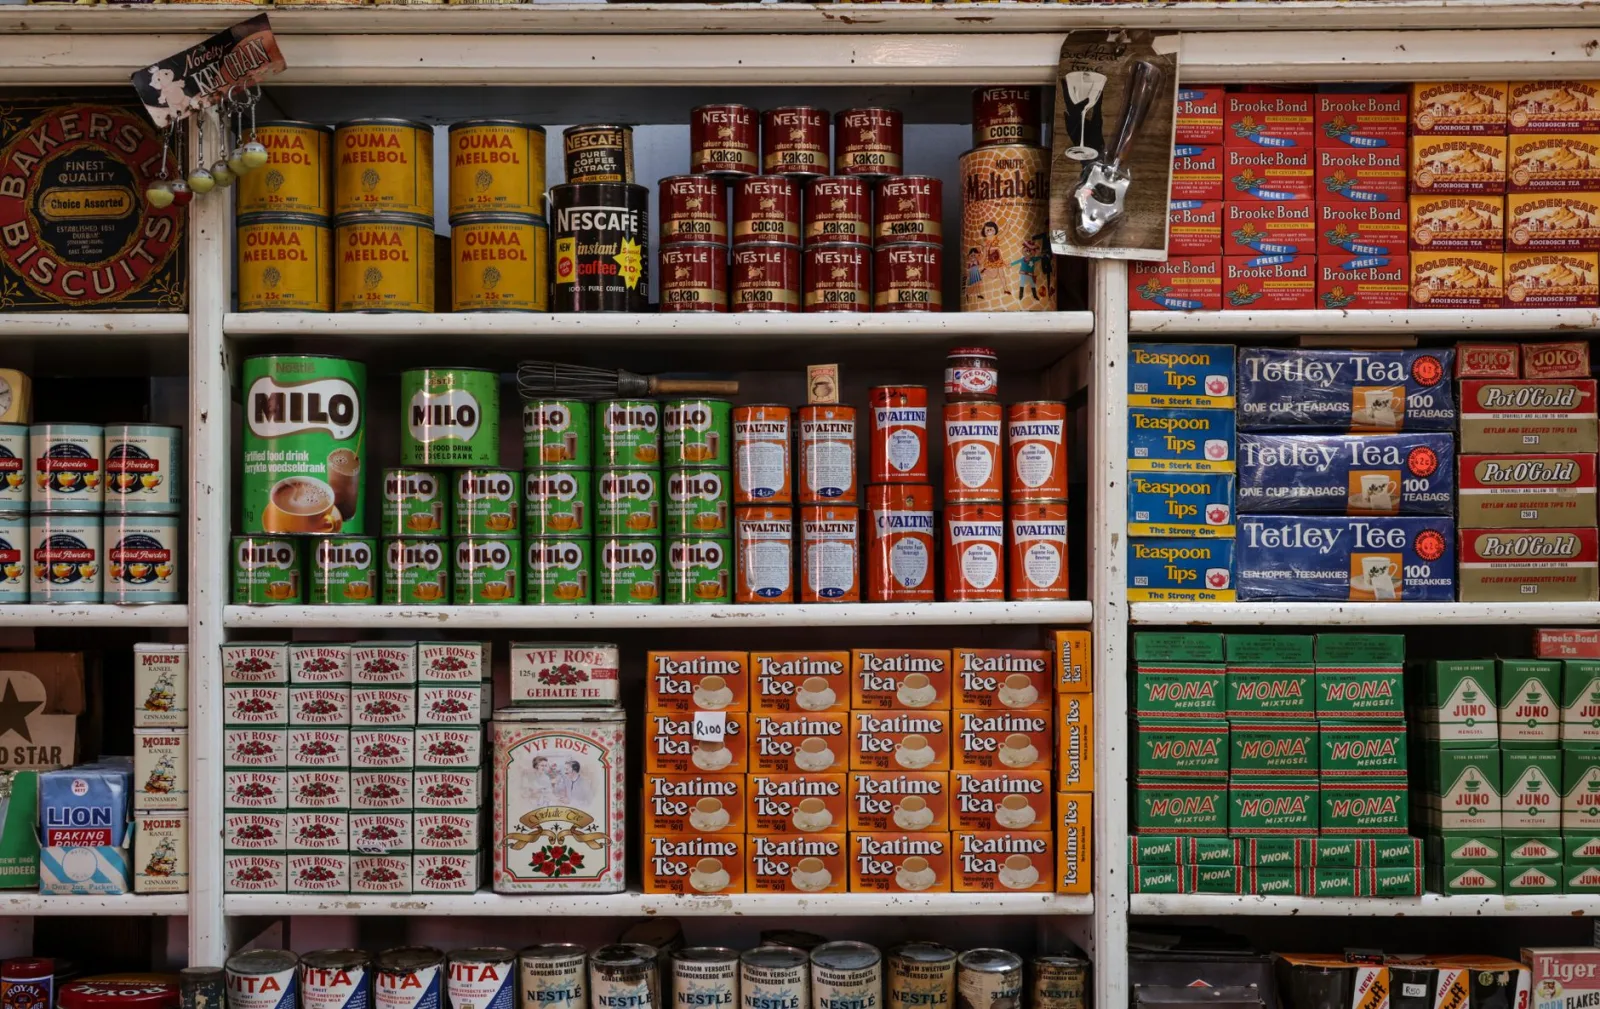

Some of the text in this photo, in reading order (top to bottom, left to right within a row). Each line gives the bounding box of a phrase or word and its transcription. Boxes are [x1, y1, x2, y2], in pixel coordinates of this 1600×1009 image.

[191, 37, 271, 97] KEY CHAIN
[1230, 99, 1308, 112] Brooke Bond
[703, 111, 749, 125] NESTLÉ
[990, 125, 1023, 138] cocoa
[345, 134, 400, 149] OUMA
[566, 132, 622, 149] NESCAFÉ
[1259, 137, 1285, 146] FREE!
[1, 113, 143, 199] BAKERS
[342, 151, 407, 165] MEELBOL
[575, 157, 614, 167] COFFEE
[710, 150, 742, 163] kakao
[66, 161, 104, 170] FINEST
[573, 164, 616, 174] EXTRACT
[995, 159, 1024, 169] MINUTE
[58, 172, 114, 183] QUALITY
[744, 181, 792, 197] NESTLÉ
[881, 180, 930, 196] NESTLÉ
[51, 197, 123, 209] Choice Assorted
[558, 207, 638, 233] NESCAFÉ
[751, 221, 784, 233] cocoa
[891, 221, 924, 234] kakao
[246, 231, 300, 247] OUMA
[465, 232, 520, 247] OUMA
[559, 243, 570, 252] NEW
[577, 242, 618, 255] instant
[2, 214, 172, 296] BISCUITS
[243, 248, 308, 263] MEELBOL
[461, 247, 527, 262] MEELBOL
[578, 260, 617, 275] coffee
[1228, 264, 1308, 280] Brooke Bond
[1132, 350, 1210, 368] Teaspoon
[1245, 357, 1344, 387] Tetley
[1350, 356, 1409, 382] Tea
[1163, 371, 1197, 389] Tips
[1169, 397, 1192, 405] Sterk
[1407, 396, 1433, 408] 100
[1484, 387, 1575, 407] Pot O'Gold
[254, 392, 354, 424] MILO
[1244, 402, 1350, 412] ONE CUP TEABAGS
[1407, 409, 1454, 418] TEABAGS
[413, 405, 475, 427] MILO
[948, 425, 998, 436] OVALTINE
[266, 450, 309, 461] food drink
[268, 462, 326, 474] voedseldrank
[953, 525, 1002, 536] OVALTINE
[1016, 524, 1065, 536] OVALTINE
[1149, 527, 1166, 535] The
[1169, 527, 1196, 536] Strong
[1349, 523, 1406, 548] Tee
[1243, 523, 1344, 554] Tetley
[62, 550, 92, 559] Powder
[242, 548, 291, 563] MILO
[669, 547, 719, 563] MILO
[1262, 571, 1348, 579] KOPPIE TEESAKKIES
[1404, 565, 1431, 578] 100
[1404, 578, 1452, 586] TEESAKKIES
[1542, 633, 1598, 644] Brooke Bond
[228, 648, 276, 660] VYF ROSE
[1560, 645, 1577, 654] Tea
[142, 655, 180, 665] MOIR'S
[527, 650, 605, 666] VYF ROSE
[959, 653, 1046, 673] Teatime
[654, 655, 742, 676] Teatime
[231, 671, 276, 680] CEYLON TEE
[960, 673, 997, 691] Tee
[654, 675, 692, 695] Tea
[527, 689, 600, 698] GEHALTE TEE
[1175, 699, 1216, 708] MENGSEL
[1261, 698, 1305, 707] MIXTURE
[1453, 704, 1486, 717] JUNO
[523, 738, 591, 755] VYF ROSE
[1065, 699, 1081, 786] Teatime Tee
[14, 746, 61, 765] STAR
[1516, 793, 1550, 805] JUNO
[47, 807, 112, 826] LION
[420, 815, 470, 828] FIVE ROSES
[54, 831, 104, 840] BAKING
[421, 837, 468, 848] CEYLON TEA
[1462, 847, 1487, 857] JUNO
[1540, 956, 1596, 984] Tiger
[1358, 970, 1377, 995] NEW!
[1438, 971, 1456, 998] NUUT!
[7, 983, 40, 998] ROYAL
[527, 987, 581, 1001] NESTLÉ
[1566, 992, 1600, 1009] FLAKES
